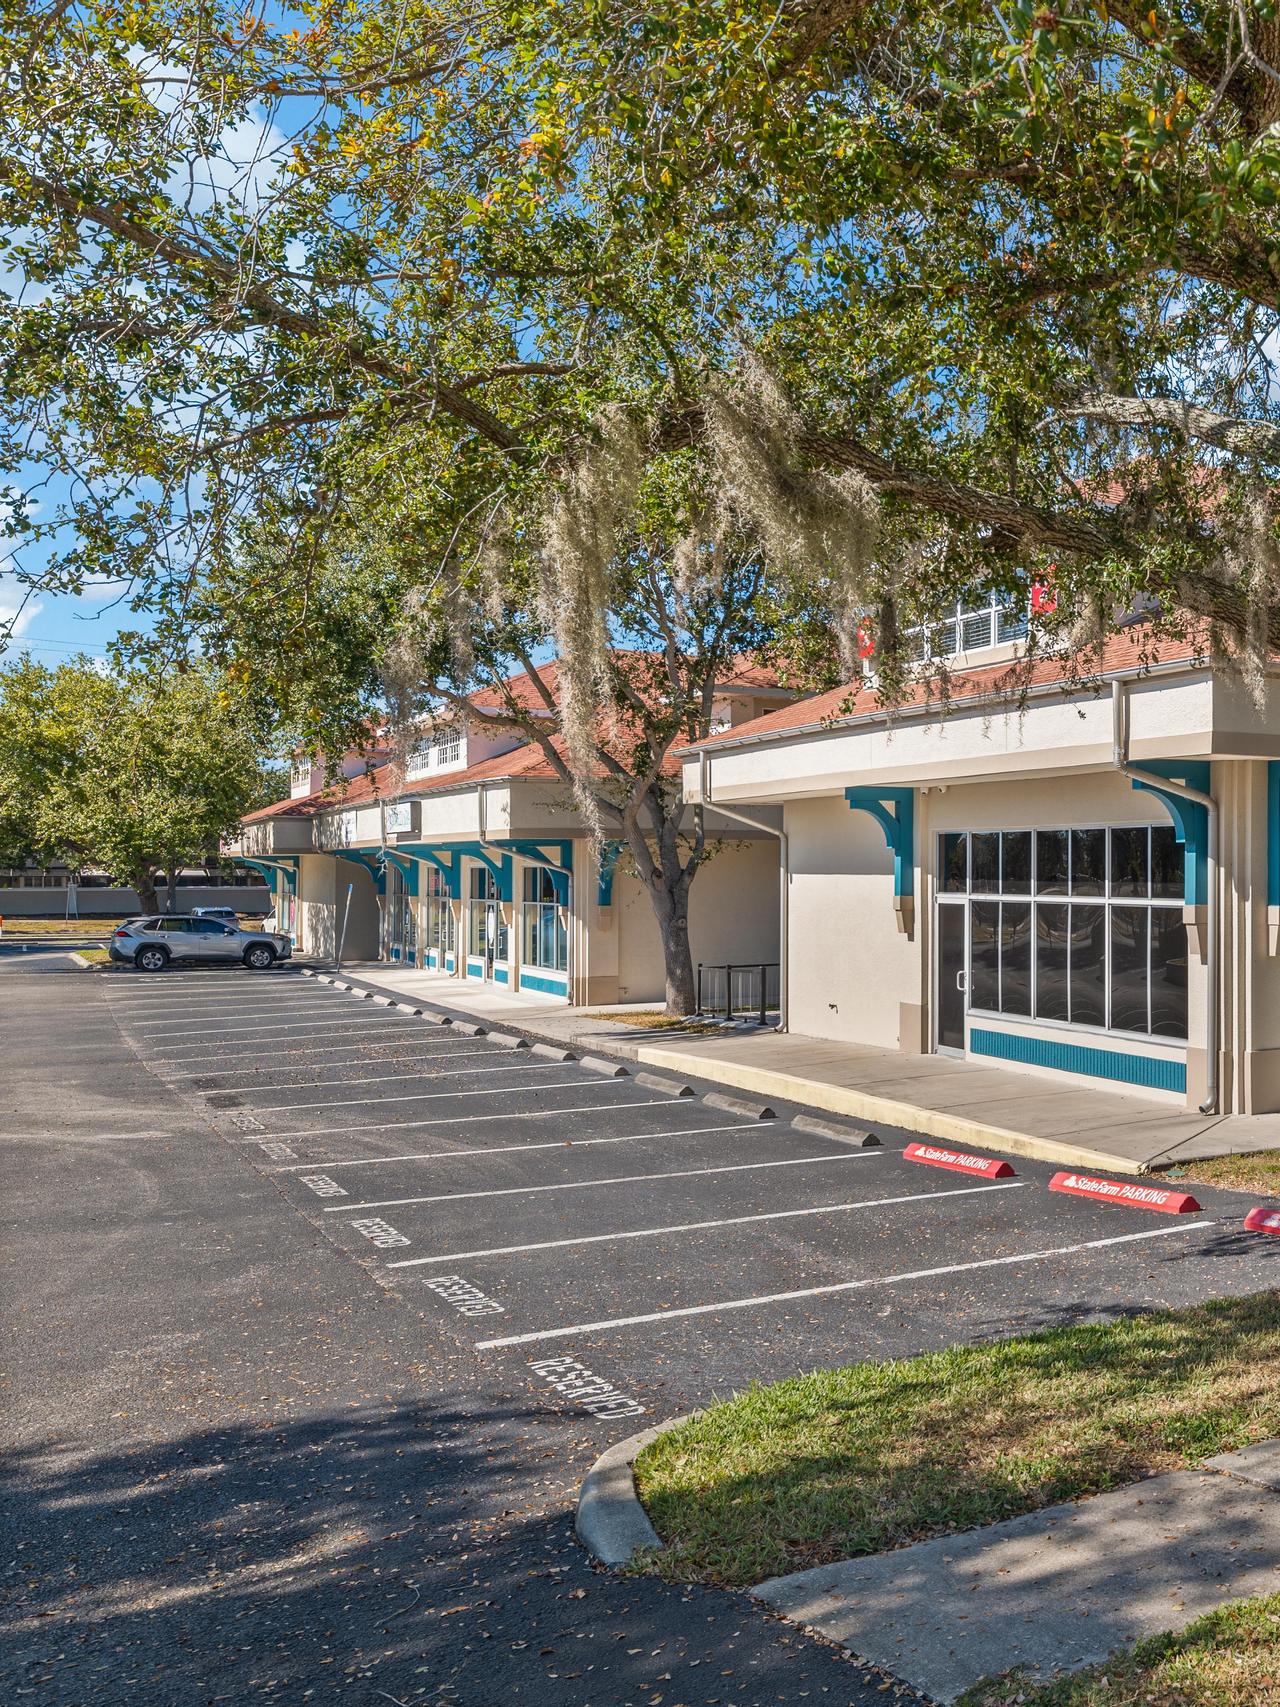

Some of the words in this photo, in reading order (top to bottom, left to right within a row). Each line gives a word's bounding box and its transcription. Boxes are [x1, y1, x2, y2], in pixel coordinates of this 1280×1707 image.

[955, 1155, 992, 1170] PARKING
[1118, 1186, 1170, 1205] PARKING
[421, 1275, 505, 1317] RESERVED
[526, 1356, 647, 1420] RESERVED
